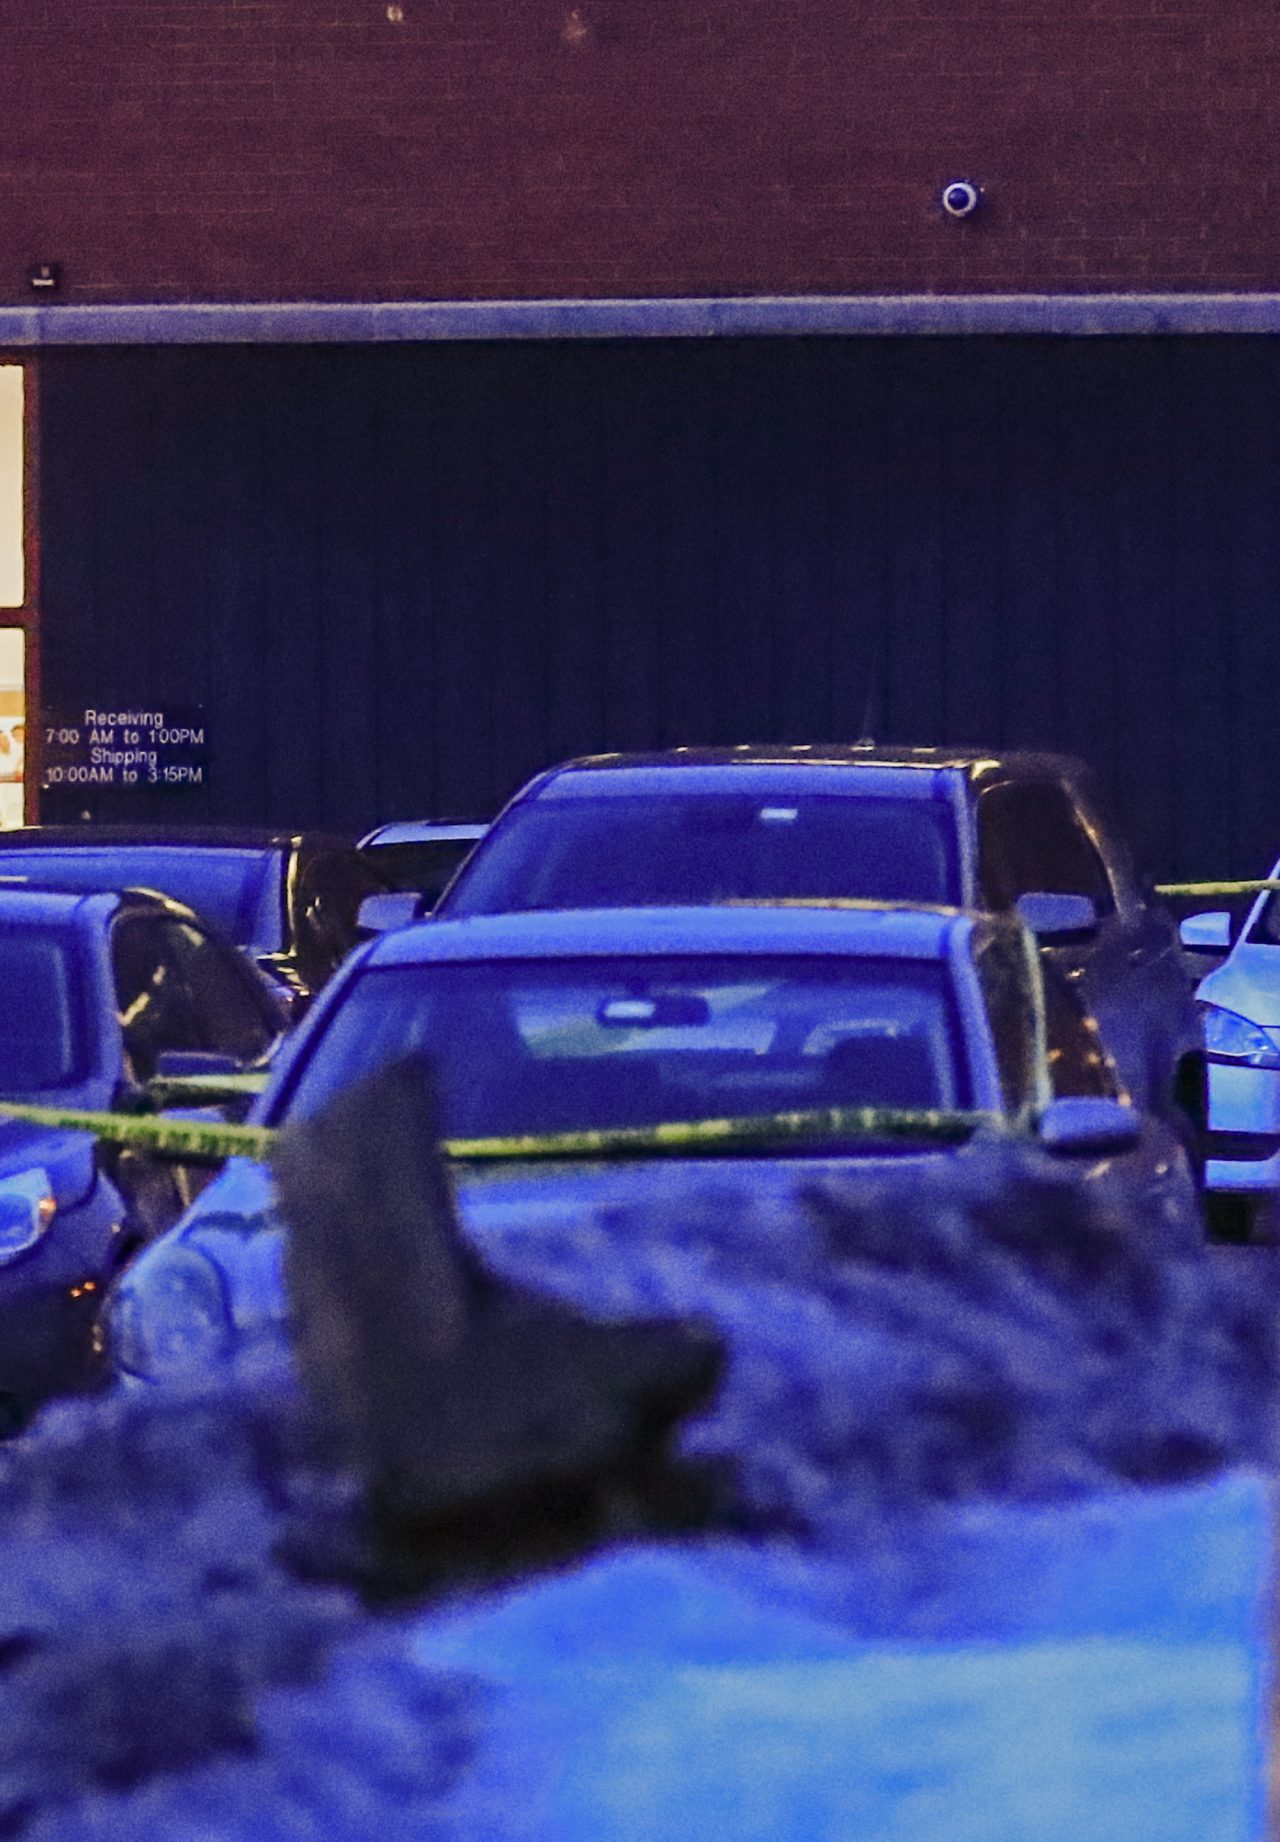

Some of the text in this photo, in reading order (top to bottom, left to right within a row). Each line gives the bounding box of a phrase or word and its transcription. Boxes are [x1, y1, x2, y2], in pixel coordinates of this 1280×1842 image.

[85, 710, 163, 728] Receiving
[90, 729, 113, 743] AM
[124, 729, 139, 743] to
[91, 747, 157, 766] Shipping
[123, 767, 137, 782] to
